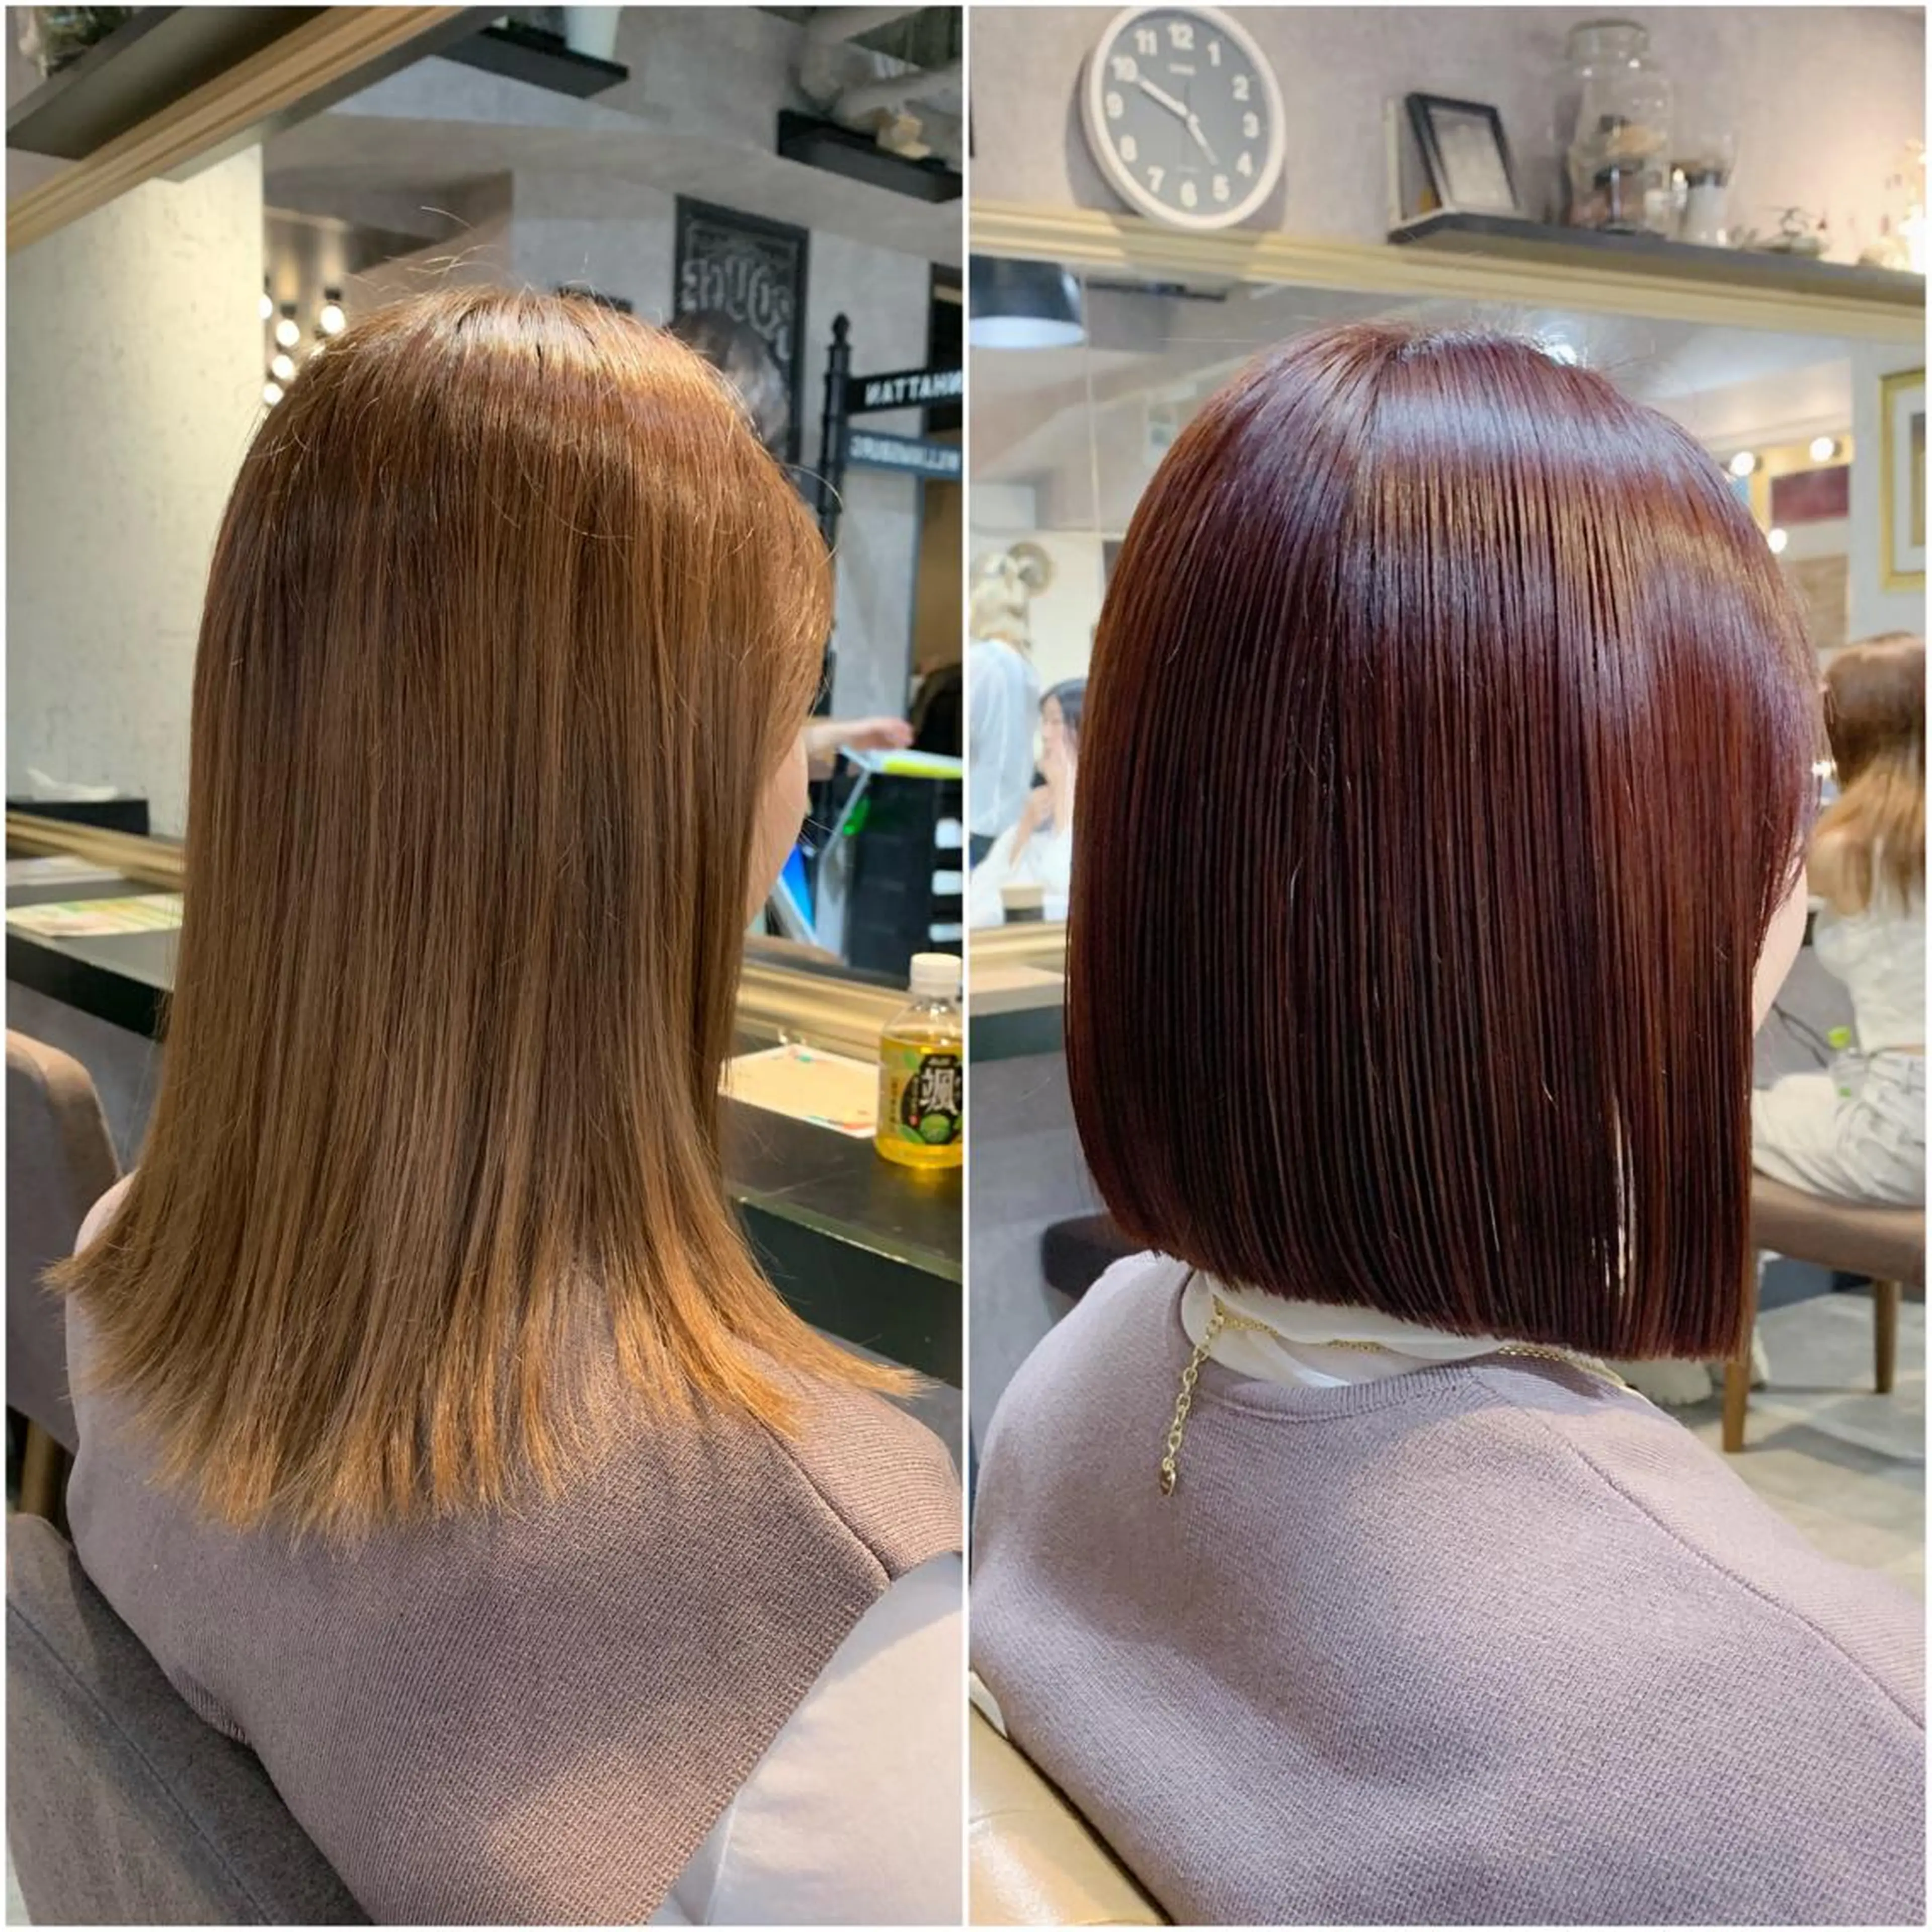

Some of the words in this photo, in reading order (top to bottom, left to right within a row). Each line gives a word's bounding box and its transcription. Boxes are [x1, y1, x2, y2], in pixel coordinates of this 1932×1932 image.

[1136, 29, 1157, 56] 11
[1168, 22, 1194, 49] 12
[1208, 40, 1221, 66] 1
[1111, 55, 1138, 81] 10
[1232, 73, 1249, 101] 2
[1107, 91, 1123, 119] 9
[1243, 111, 1259, 138] 3
[1120, 134, 1137, 162] 8
[1236, 151, 1252, 177] 4
[1147, 166, 1165, 192] 7
[1213, 174, 1230, 201] 5
[1180, 180, 1197, 207] 6
